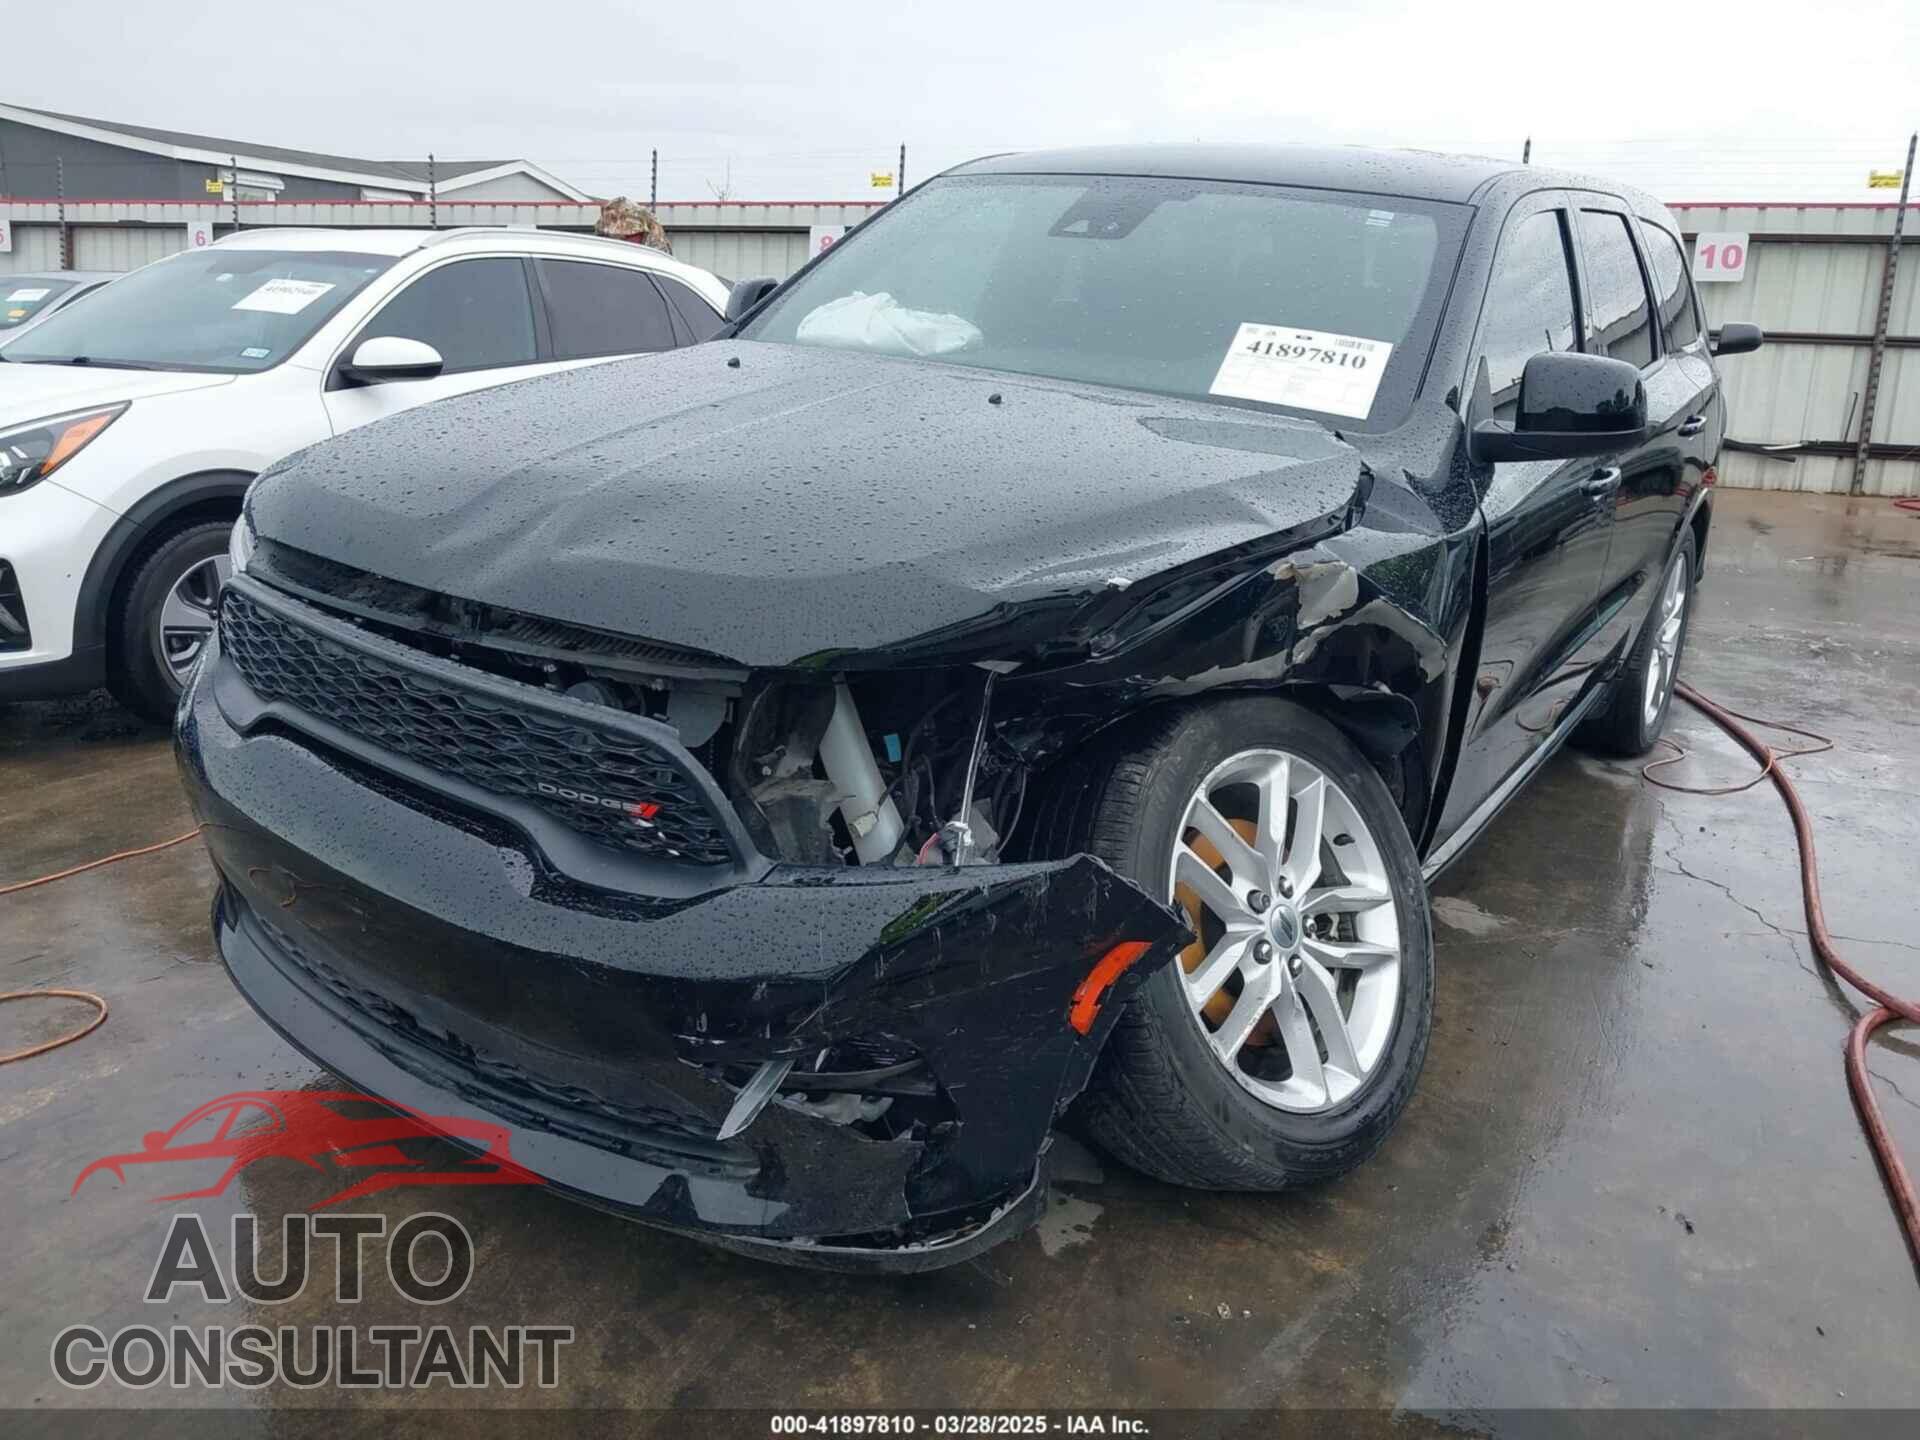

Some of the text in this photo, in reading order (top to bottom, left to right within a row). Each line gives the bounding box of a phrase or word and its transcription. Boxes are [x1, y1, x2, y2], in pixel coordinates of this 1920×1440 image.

[196, 230, 206, 247] 6
[1700, 245, 1743, 269] 10
[1246, 340, 1367, 369] 41897810
[538, 782, 642, 814] DODGE
